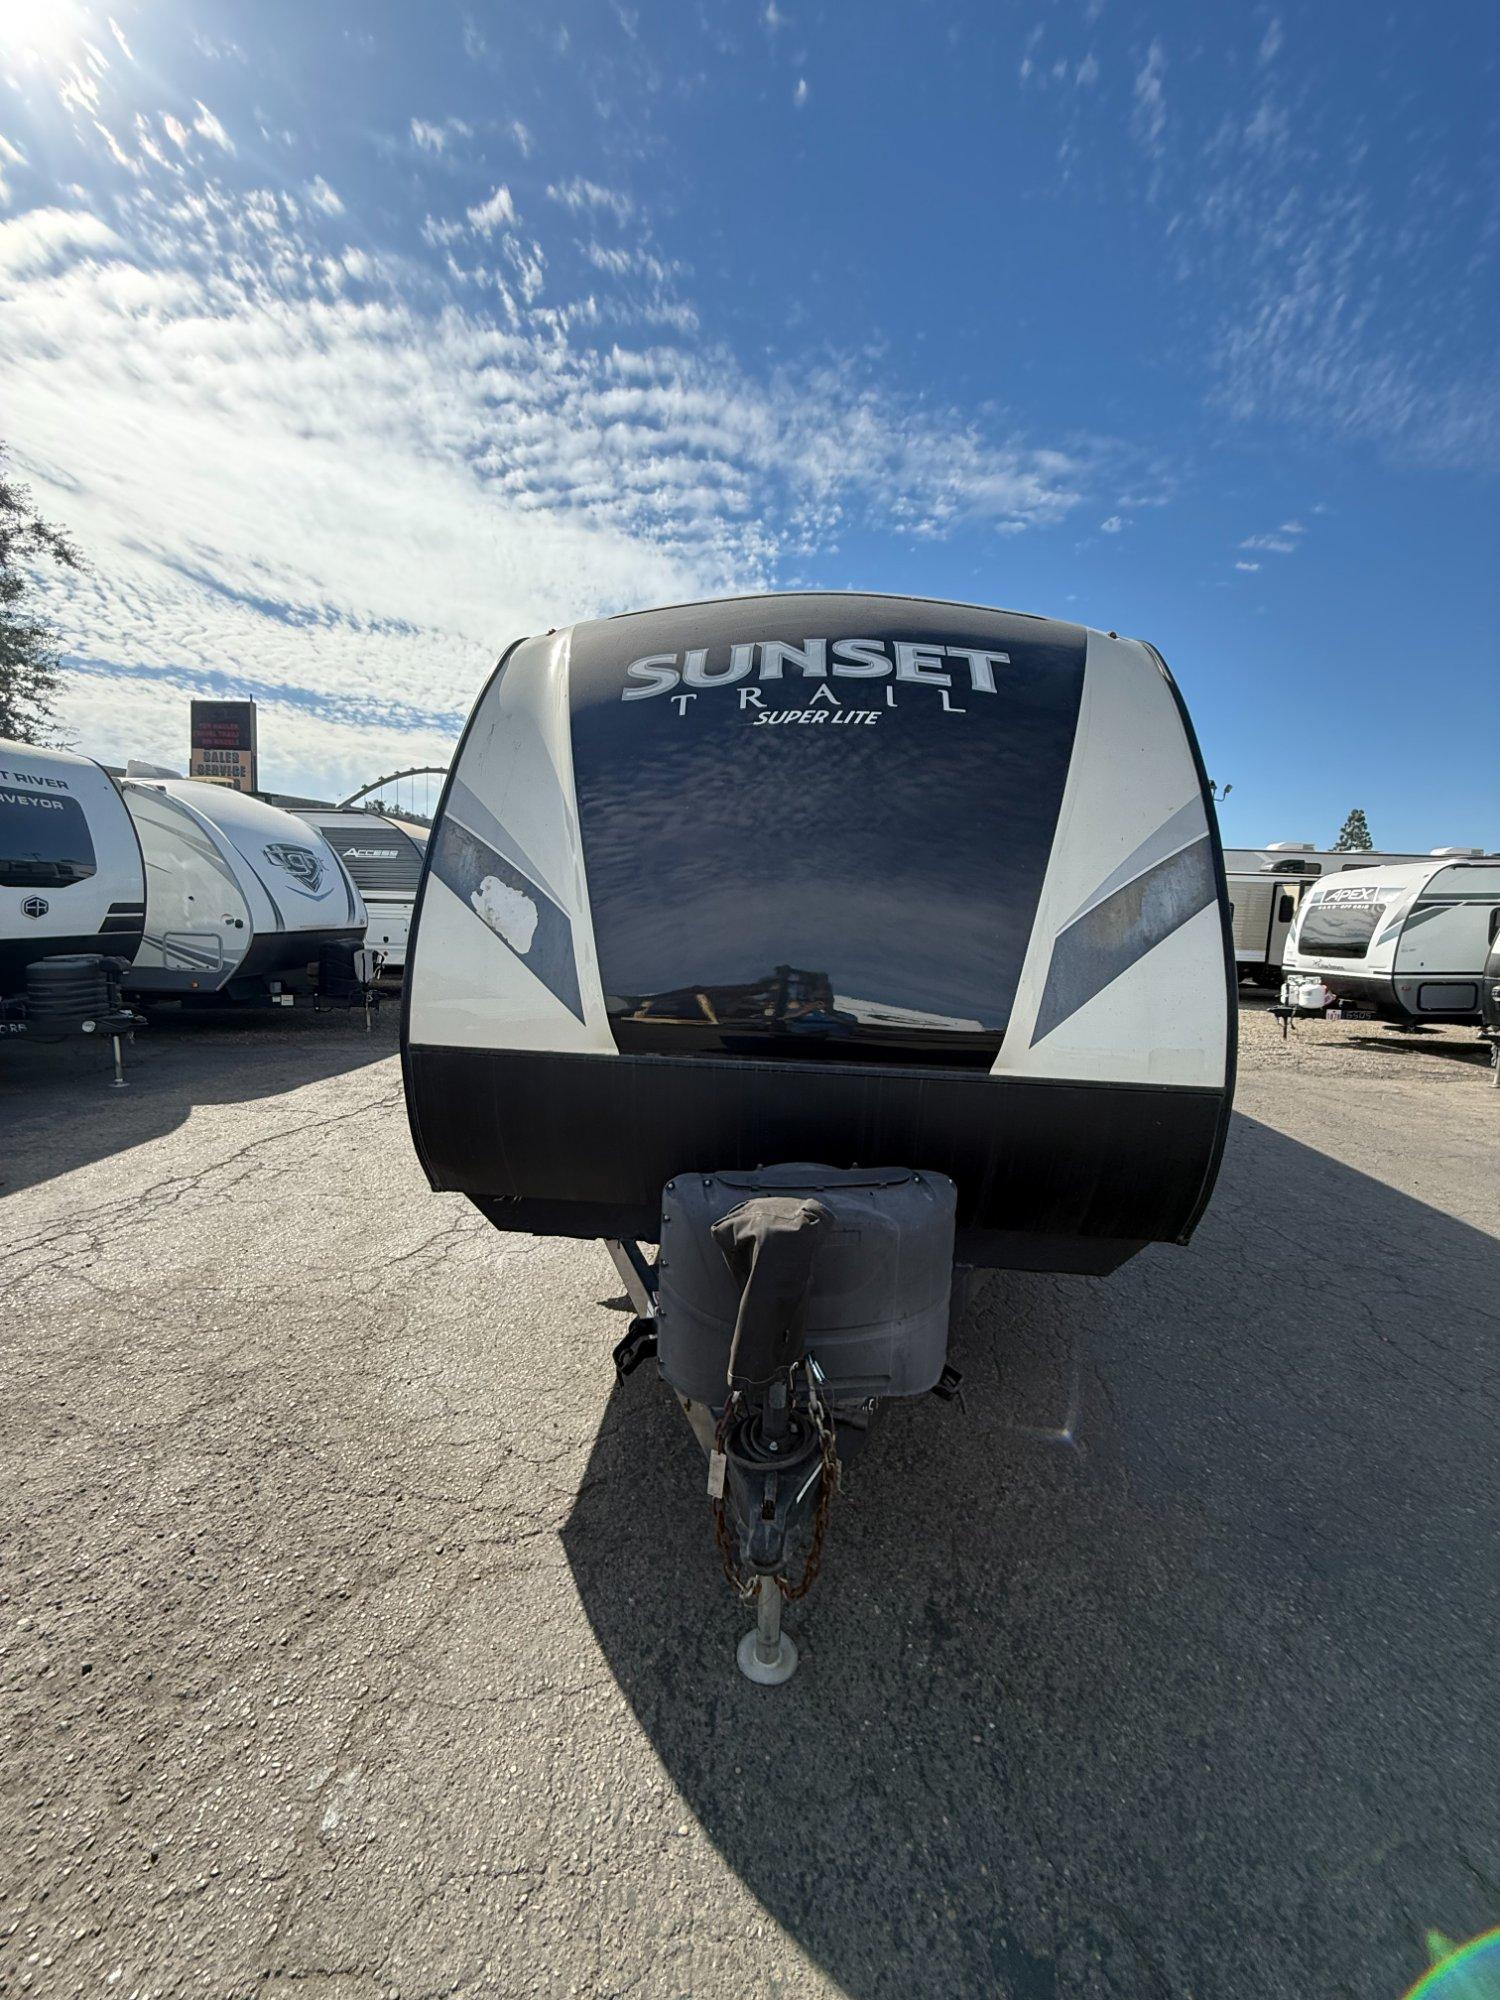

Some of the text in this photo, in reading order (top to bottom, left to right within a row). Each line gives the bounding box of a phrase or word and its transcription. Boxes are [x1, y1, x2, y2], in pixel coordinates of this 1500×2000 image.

[621, 638, 1011, 701] SUNSET
[670, 683, 967, 716] TRAIL
[753, 710, 882, 726] SUPER LITE
[203, 751, 240, 764] SALES
[197, 764, 246, 778] SERVICE
[13, 772, 70, 790] RIVER
[1325, 888, 1374, 902] APEX
